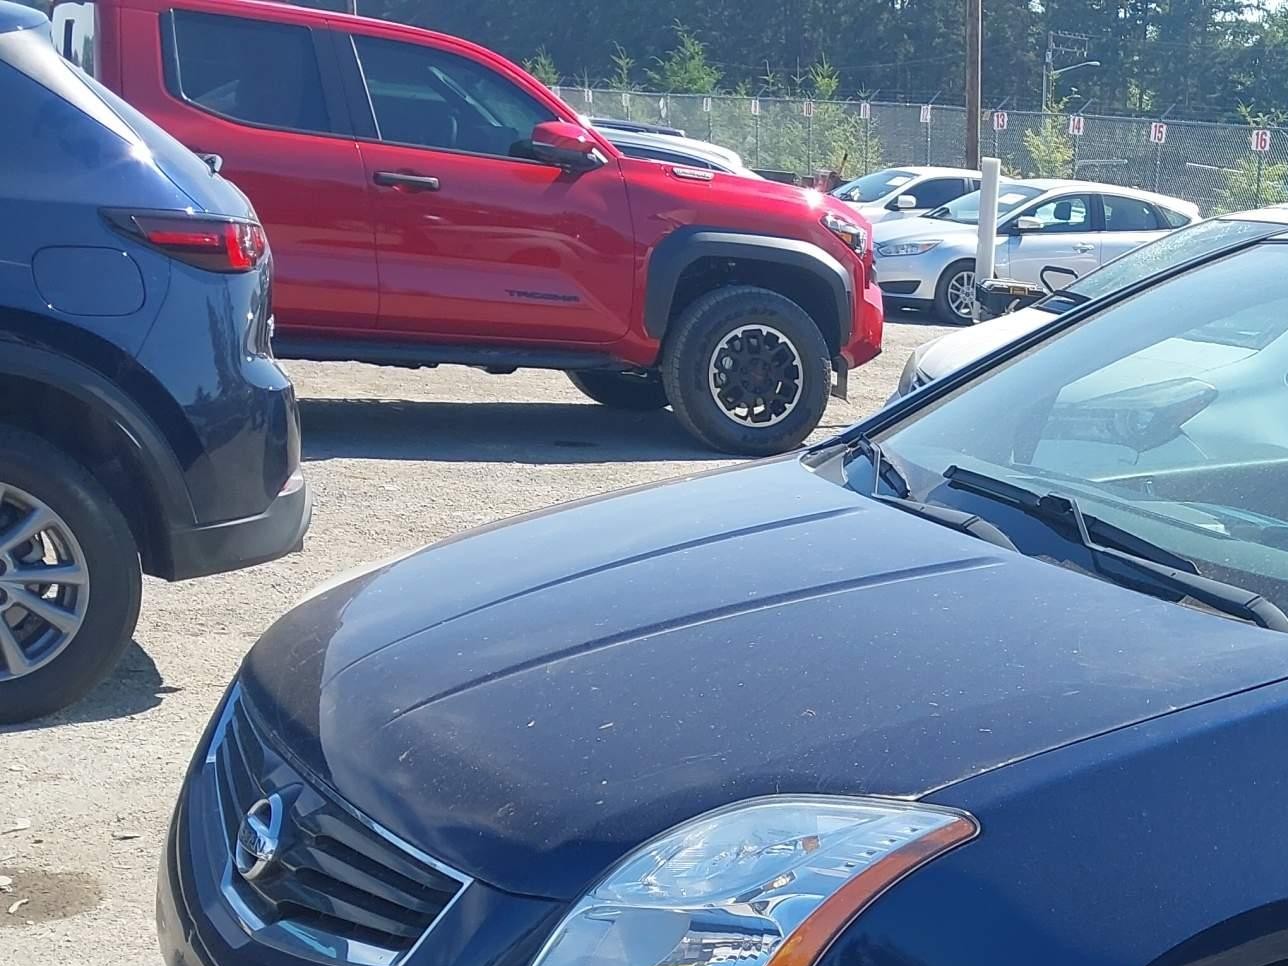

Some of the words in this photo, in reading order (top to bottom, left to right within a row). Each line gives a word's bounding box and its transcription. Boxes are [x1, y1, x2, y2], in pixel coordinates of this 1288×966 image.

[996, 113, 1005, 129] 13
[1071, 117, 1082, 134] 14
[1153, 124, 1165, 142] 15
[1254, 132, 1268, 150] 16
